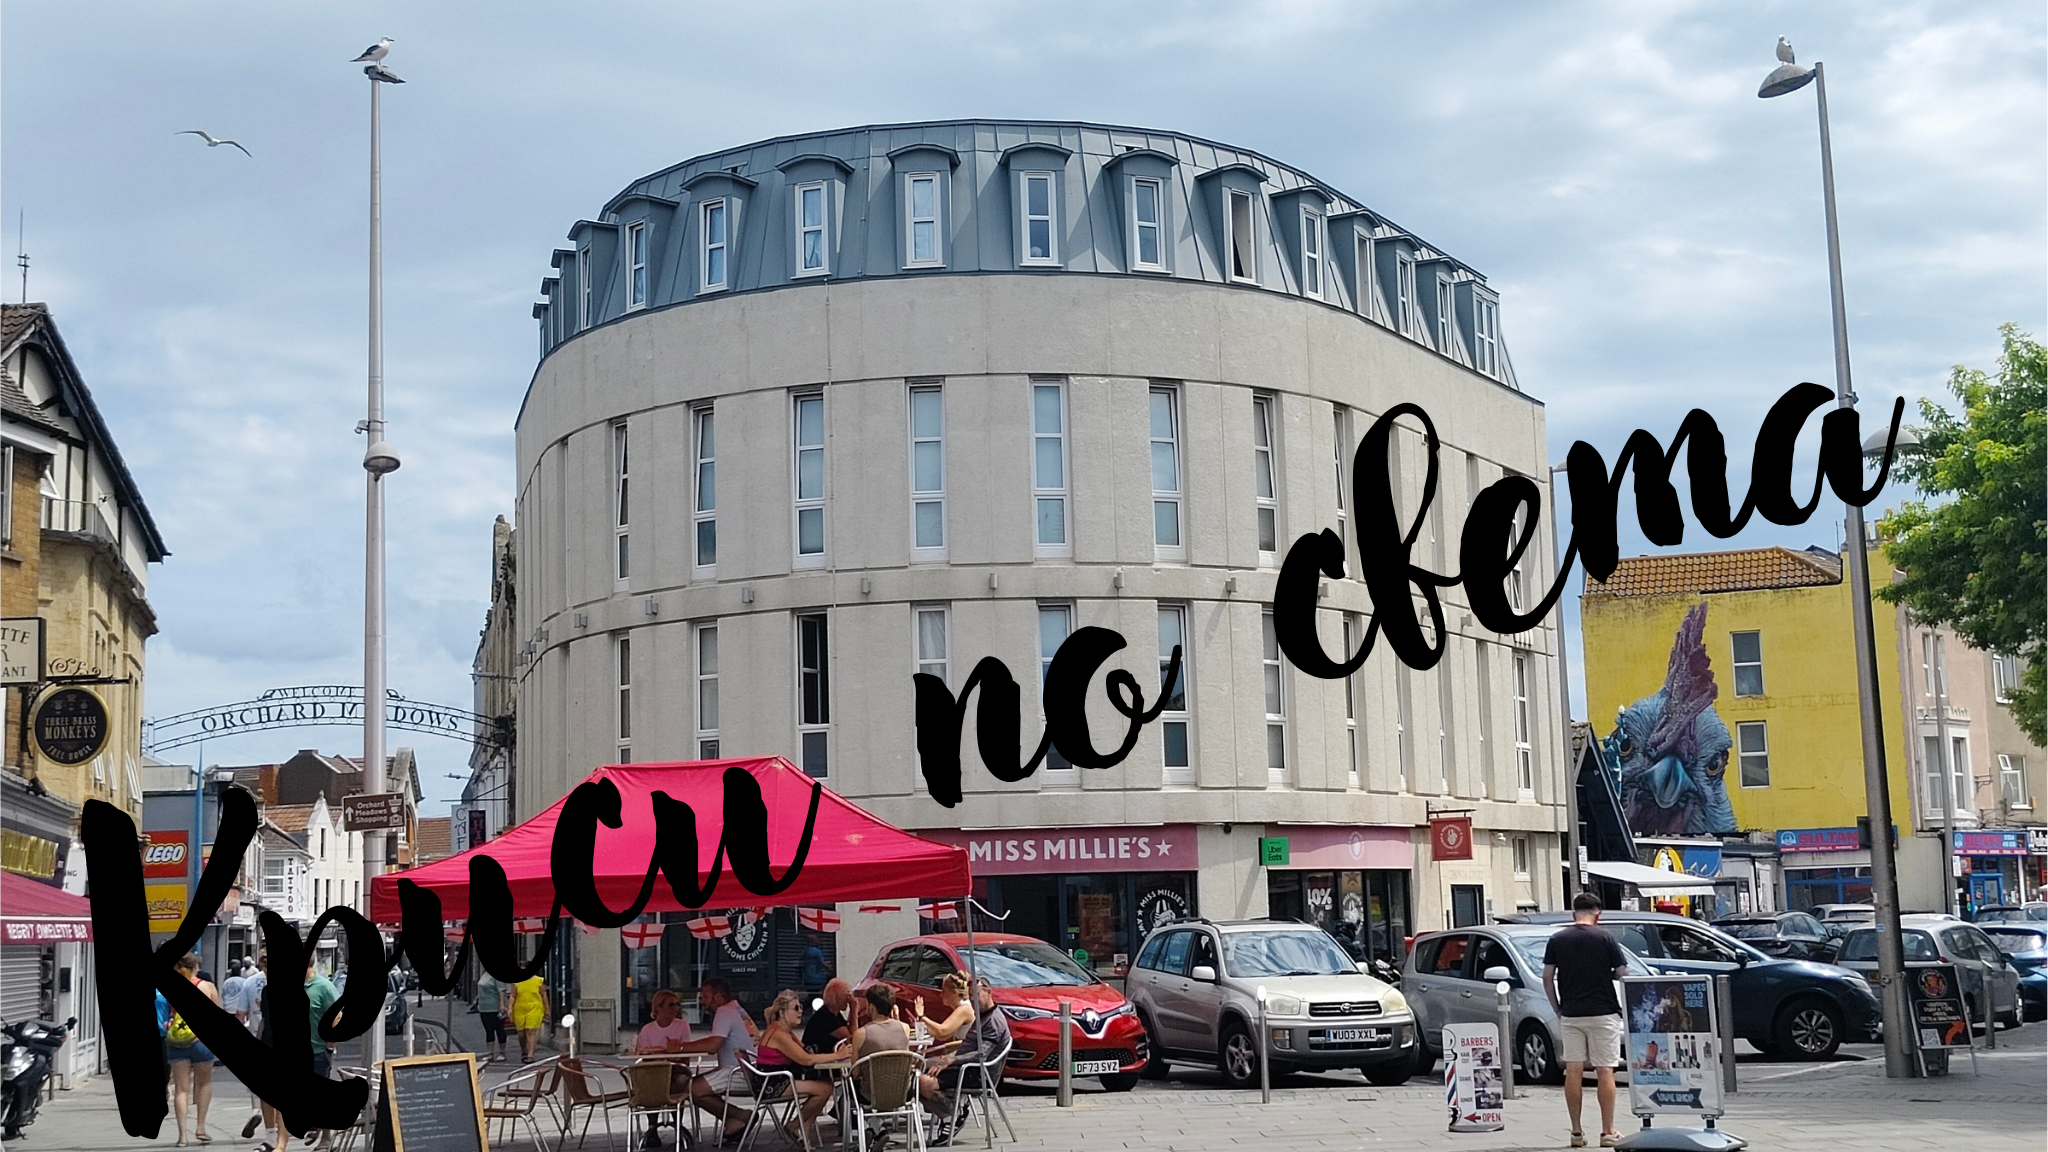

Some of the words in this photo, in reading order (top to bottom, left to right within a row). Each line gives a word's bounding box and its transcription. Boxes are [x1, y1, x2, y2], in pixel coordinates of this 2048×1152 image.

[280, 687, 356, 698] WELCOME
[45, 717, 69, 726] THREE
[72, 716, 97, 725] BRASS
[201, 703, 325, 732] ORCHARD
[340, 702, 459, 731] MDOWS
[44, 725, 97, 740] MONKEYS
[357, 801, 385, 809] Orchard
[355, 808, 387, 816] Meadows
[356, 815, 388, 824] Shopping
[455, 807, 467, 854] CAF
[969, 839, 1037, 861] MISS
[1044, 837, 1151, 860] MILLIE'S
[1267, 845, 1282, 853] Uber
[145, 846, 184, 863] LEGO
[1268, 853, 1282, 861] Eats
[1139, 890, 1157, 908] MISS
[37, 924, 73, 939] OMELETTE
[73, 924, 88, 939] BAR
[746, 931, 769, 960] CHICKEN
[1682, 983, 1706, 992] VAPES
[1684, 991, 1703, 1000] SOLD
[1684, 999, 1704, 1008] HERE
[1331, 1030, 1356, 1042] WU03
[1358, 1029, 1375, 1041] XXL
[1460, 1037, 1494, 1047] BARBERS
[1076, 1062, 1100, 1073] DF73
[1102, 1061, 1119, 1072] SVZ
[1656, 1092, 1676, 1102] VAPE
[1676, 1092, 1694, 1102] SHOP
[1482, 1112, 1501, 1122] OPEN
